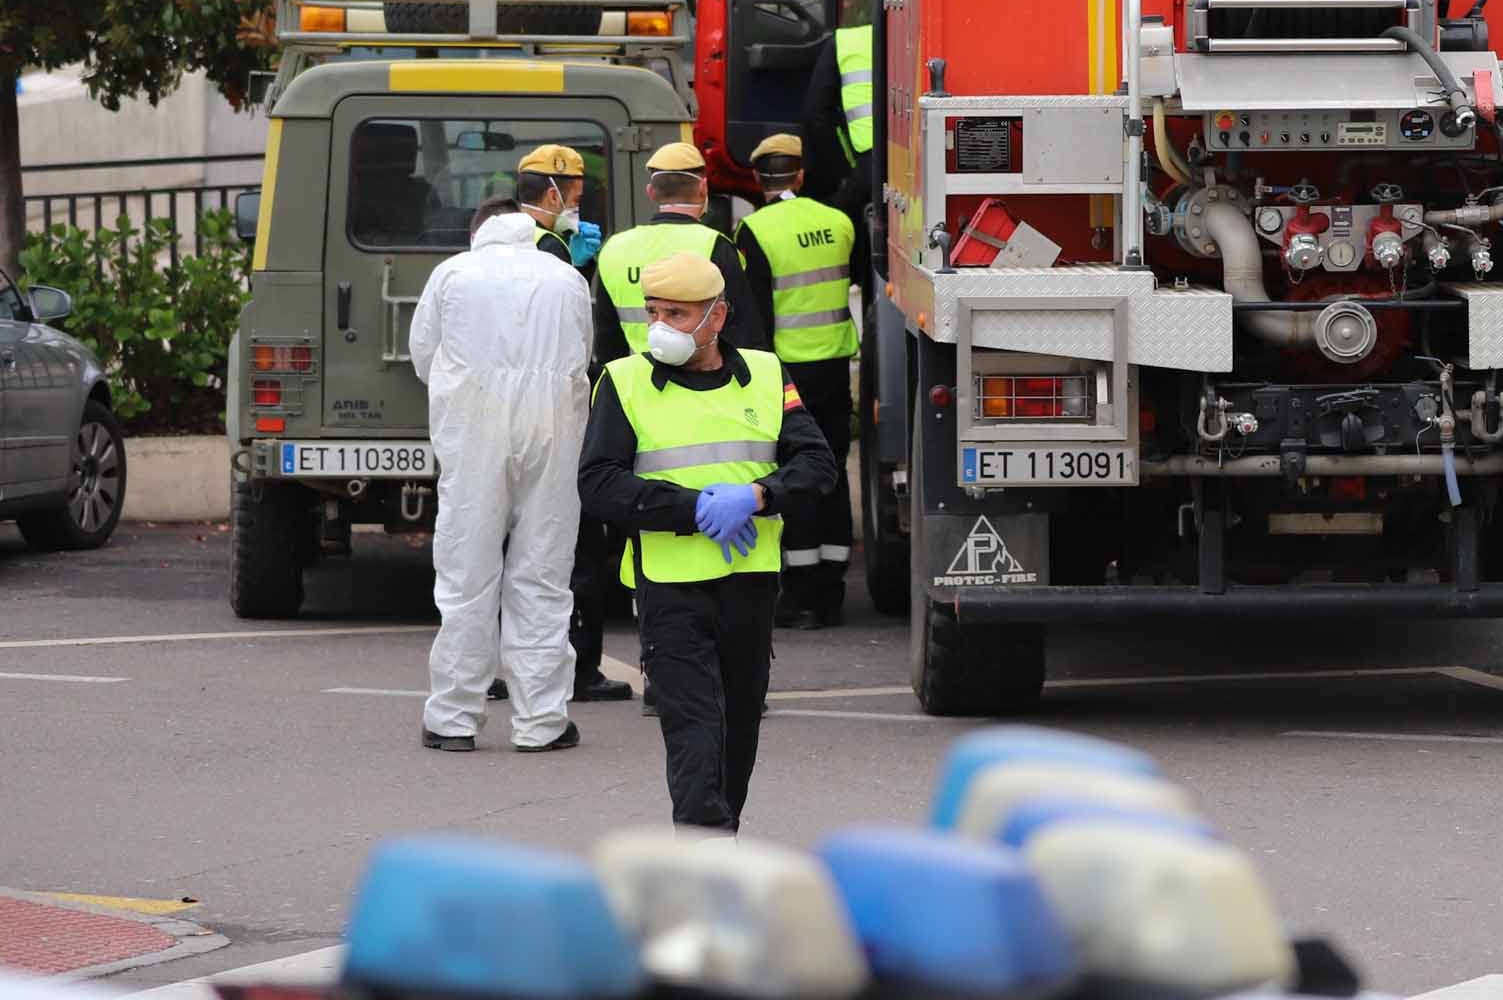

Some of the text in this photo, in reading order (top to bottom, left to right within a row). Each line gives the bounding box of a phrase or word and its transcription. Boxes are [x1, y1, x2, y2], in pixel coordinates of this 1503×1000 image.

[797, 229, 834, 248] UME
[300, 447, 425, 471] ET 110388
[980, 451, 1125, 479] ET 113091
[934, 572, 1037, 586] PROTEC-FIRE
